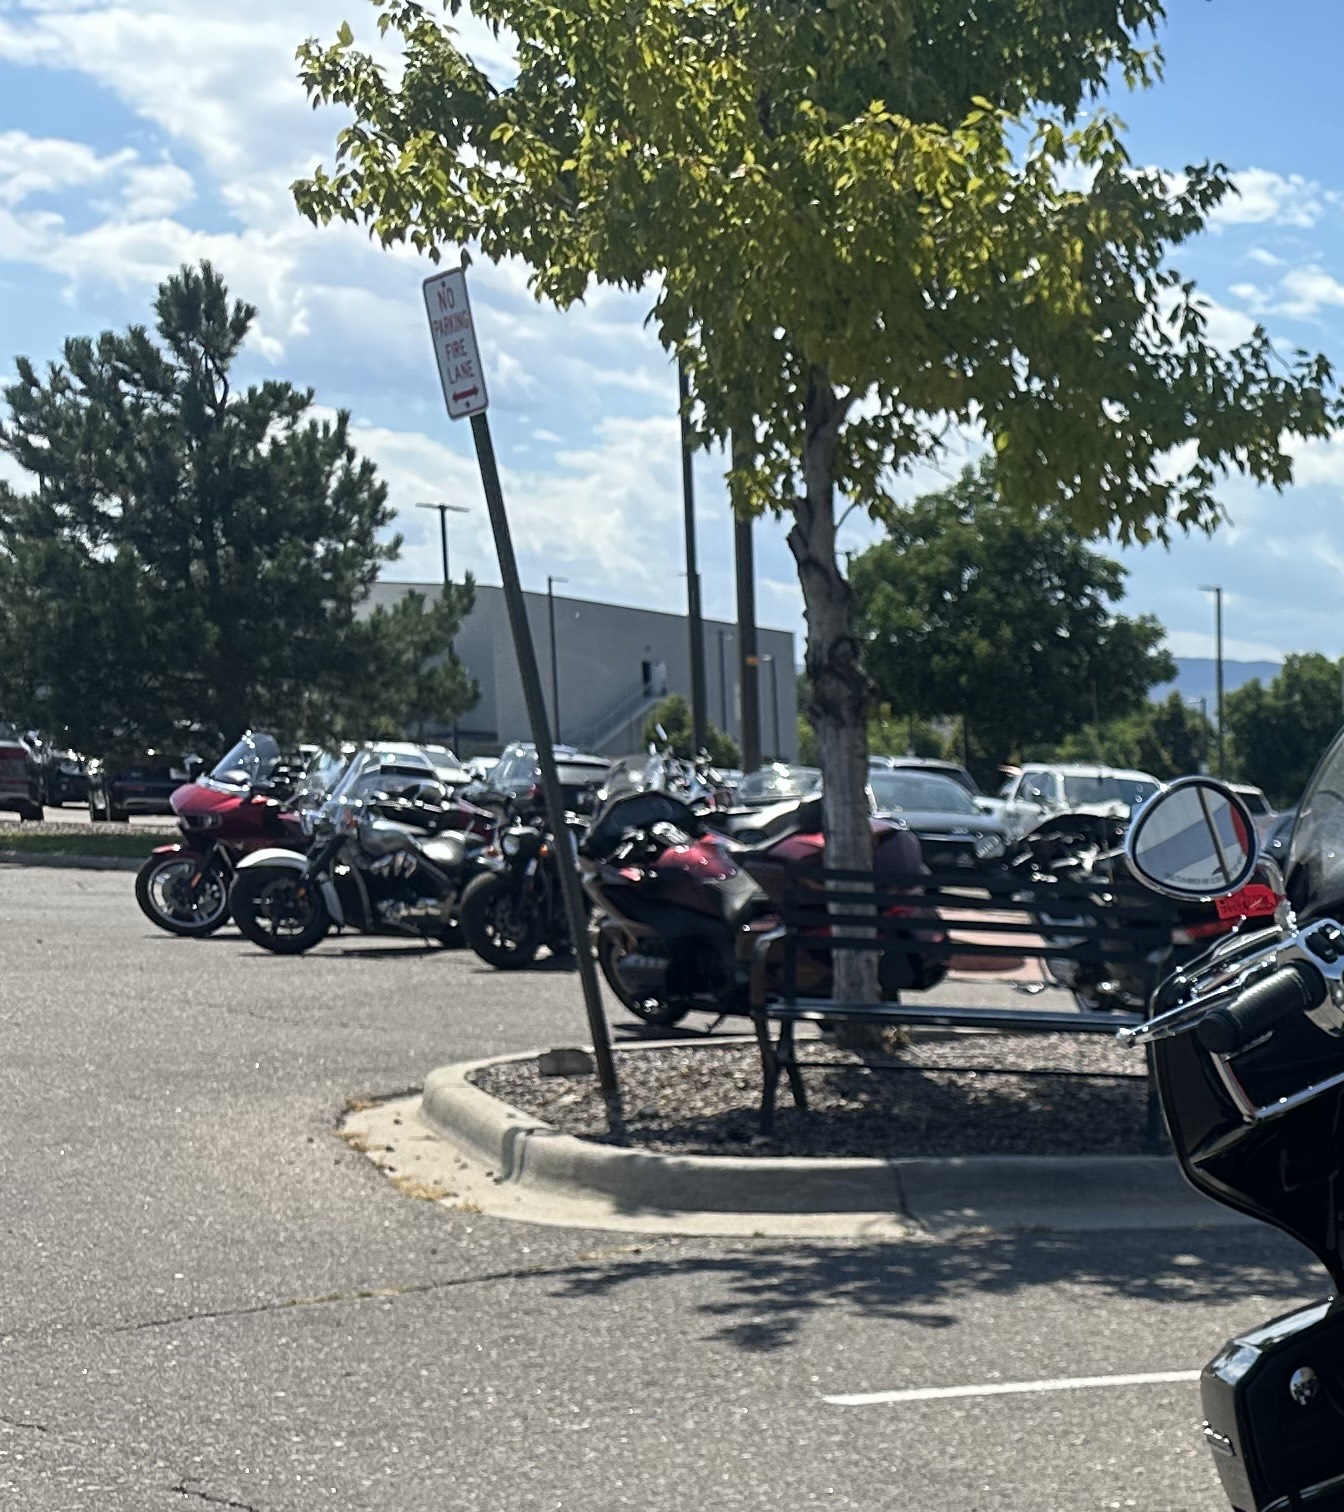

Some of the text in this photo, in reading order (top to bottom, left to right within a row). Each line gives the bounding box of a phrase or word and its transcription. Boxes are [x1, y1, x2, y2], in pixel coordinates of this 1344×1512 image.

[437, 287, 456, 312] NO
[432, 310, 470, 337] PARKING
[444, 338, 468, 362] FIRE
[447, 359, 475, 384] LANE
